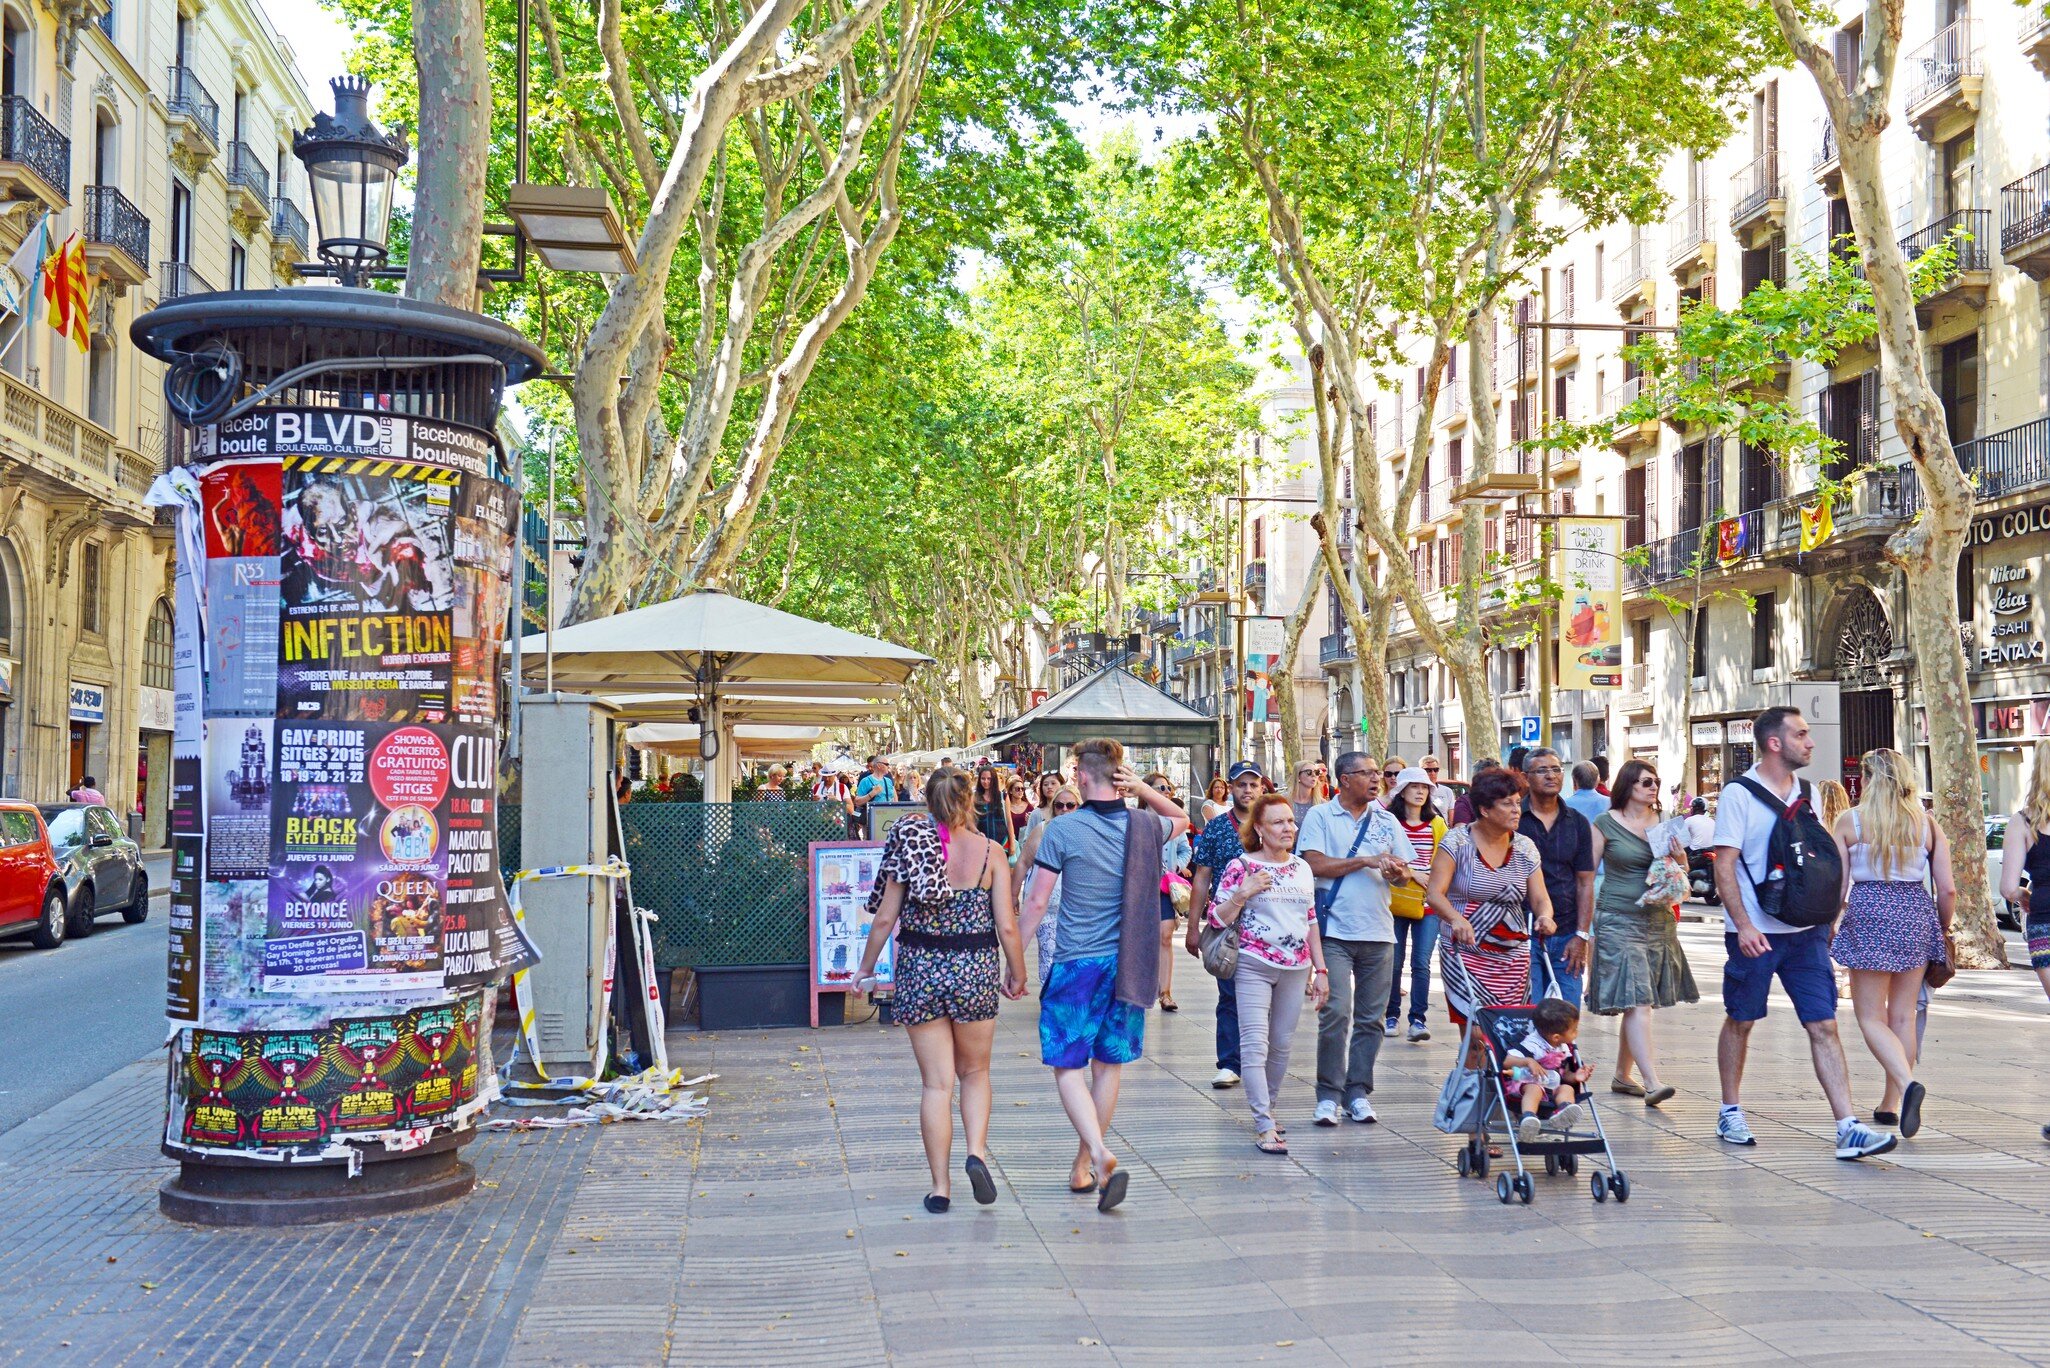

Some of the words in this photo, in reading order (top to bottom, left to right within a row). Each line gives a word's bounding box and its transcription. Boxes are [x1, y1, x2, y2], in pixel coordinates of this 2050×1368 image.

[275, 412, 380, 447] BLVD
[380, 416, 393, 455] CLUB
[220, 435, 267, 454] boule
[275, 444, 333, 452] BOULEVARD
[334, 444, 379, 455] CULTURE
[1577, 527, 1603, 538] MIND
[1575, 537, 1606, 548] WHAT
[1581, 549, 1601, 559] YOU
[1575, 557, 1606, 569] DRINK
[1989, 565, 2028, 585] Nikon
[1990, 586, 2029, 616] Leica
[289, 604, 318, 615] ESTRENO
[319, 603, 329, 613] 24
[330, 603, 340, 613] DE
[340, 603, 360, 612] JUNIO
[1990, 621, 2029, 638] ASAHI
[284, 615, 451, 661] INFECTION
[382, 654, 412, 665] HORROR
[413, 652, 451, 664] EXPERIENCE
[1979, 641, 2040, 665] PENTAX
[349, 672, 359, 680] AL
[360, 671, 405, 680] APOCALIPSIS
[405, 670, 433, 680] ZOMBIE
[310, 681, 322, 691] EN
[322, 681, 332, 691] EL
[332, 680, 364, 690] MUSEO
[364, 680, 376, 690] DE
[376, 679, 399, 690] CERA
[399, 681, 408, 690] DE
[1989, 706, 2020, 730] JVC
[1525, 719, 1537, 739] P
[316, 729, 365, 747] PRIDE
[394, 735, 427, 745] SHOWS
[427, 736, 435, 746] &
[281, 746, 328, 761] SITGES
[330, 747, 365, 762] 2015
[386, 745, 440, 756] CONCIERTOS
[376, 756, 447, 770] GRATUITOS
[280, 770, 292, 782] 18
[297, 770, 309, 782] 19
[314, 770, 328, 783] 20
[332, 771, 345, 783] 21
[349, 771, 364, 783] 22
[392, 783, 433, 795] SITGES
[451, 798, 470, 814] 18.06
[286, 817, 357, 834] BLACK
[285, 833, 319, 844] EYED
[323, 833, 357, 845] PEAZ
[448, 830, 479, 851] MARCO
[286, 854, 317, 862] JUEVES
[318, 854, 328, 862] 18
[329, 854, 355, 862] JUNIO
[447, 853, 472, 874] PACO
[419, 864, 440, 872] JUNIO
[376, 880, 437, 903] QUEEN
[1281, 896, 1297, 904] look
[285, 899, 347, 918] BEYONCÉ
[281, 921, 315, 929] VIERNES
[317, 921, 328, 929] 19
[328, 921, 353, 929] JUNIO
[444, 914, 467, 930] 25.06
[288, 940, 315, 950] Desfile
[316, 939, 328, 947] del
[329, 936, 359, 945] Orgullo
[375, 937, 387, 946] THE
[388, 937, 405, 945] GREAT
[406, 935, 435, 945] PRETENDER
[444, 932, 469, 954] LUCA
[266, 952, 280, 960] Gay
[281, 949, 315, 958] Domingo
[337, 944, 357, 953] junio
[278, 958, 292, 966] 17h.
[304, 954, 335, 964] esperan
[336, 951, 351, 960] más
[372, 954, 410, 962] DOMINGO
[420, 952, 438, 960] JUNIO
[305, 961, 340, 972] carrozas!
[444, 954, 473, 977] PABLO
[415, 1015, 441, 1035] JUNGLE
[443, 1015, 454, 1029] TING
[218, 1036, 237, 1044] WEEK
[289, 1035, 312, 1043] WEEK
[342, 1027, 377, 1046] JUNGLE
[379, 1027, 398, 1043] TING
[198, 1041, 222, 1057] JUNGLE
[225, 1045, 243, 1060] TING
[262, 1041, 297, 1059] JUNGLE
[299, 1041, 319, 1059] TING
[351, 1040, 387, 1049] FESTIVAL
[204, 1054, 232, 1063] FESTIVAL
[271, 1054, 307, 1062] FESTIVAL
[416, 1081, 432, 1090] OM
[434, 1078, 451, 1088] UNIT
[342, 1093, 361, 1103] OM
[365, 1091, 394, 1100] UNIT
[342, 1099, 394, 1108] REMARC
[196, 1107, 210, 1115] OM
[213, 1106, 237, 1117] UNIT
[263, 1108, 282, 1116] OM
[286, 1106, 316, 1116] UNIT
